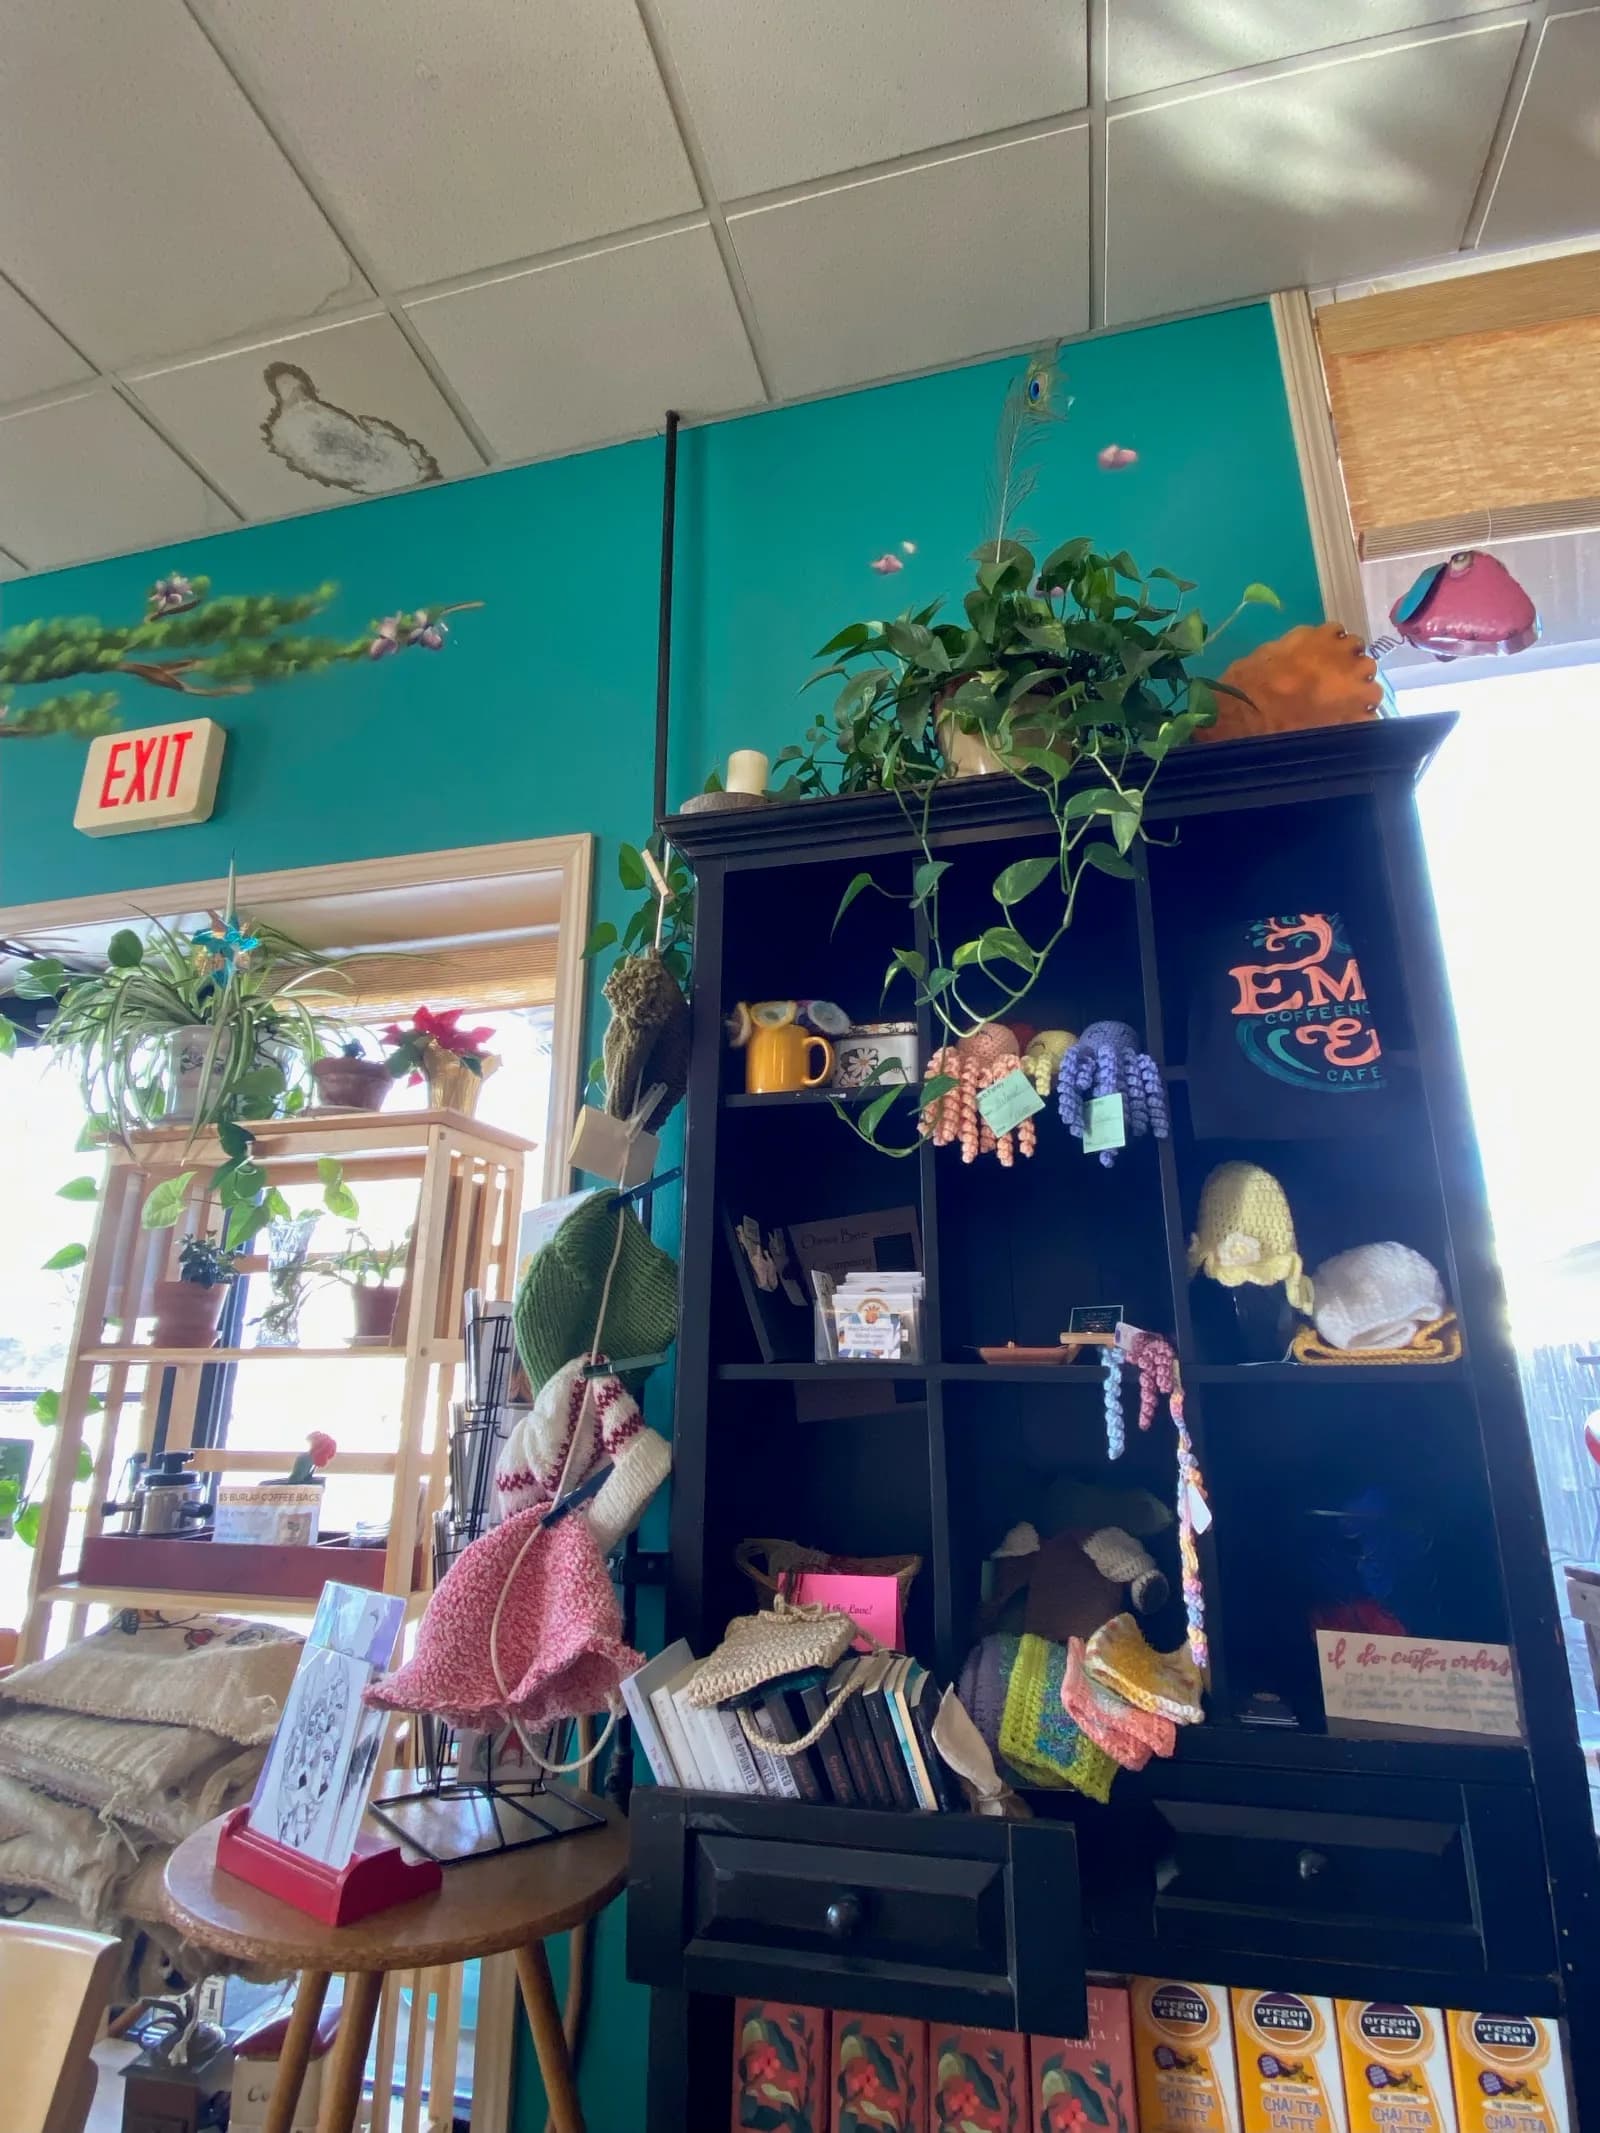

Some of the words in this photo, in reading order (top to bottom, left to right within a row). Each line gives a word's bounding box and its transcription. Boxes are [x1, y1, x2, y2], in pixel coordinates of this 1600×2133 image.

[99, 731, 194, 809] EXIT
[1326, 1066, 1382, 1082] CAFE
[262, 1493, 295, 1502] COFFEE
[296, 1493, 321, 1502] BAGS
[1356, 1643, 1387, 1667] do
[1391, 1647, 1447, 1673] custom
[1451, 1649, 1511, 1677] orders
[728, 1721, 740, 1739] THE
[735, 1743, 757, 1785] APPOINTED
[1257, 2007, 1309, 2020] oregon
[1263, 2015, 1304, 2028] chai
[1364, 2015, 1417, 2028] oregon
[1370, 2024, 1414, 2036] chai
[1477, 2022, 1532, 2036] oregon
[1483, 2031, 1529, 2044] chai
[1190, 2092, 1214, 2108] TEA
[1263, 2096, 1293, 2112] CHAI
[1296, 2100, 1322, 2117] TEA
[1167, 2104, 1208, 2122] LATTE
[1372, 2107, 1401, 2122] CHAI
[1404, 2110, 1432, 2126] TEA
[1272, 2113, 1314, 2132] LATTE
[1485, 2114, 1515, 2130] CHAI
[1518, 2117, 1547, 2133] TEA
